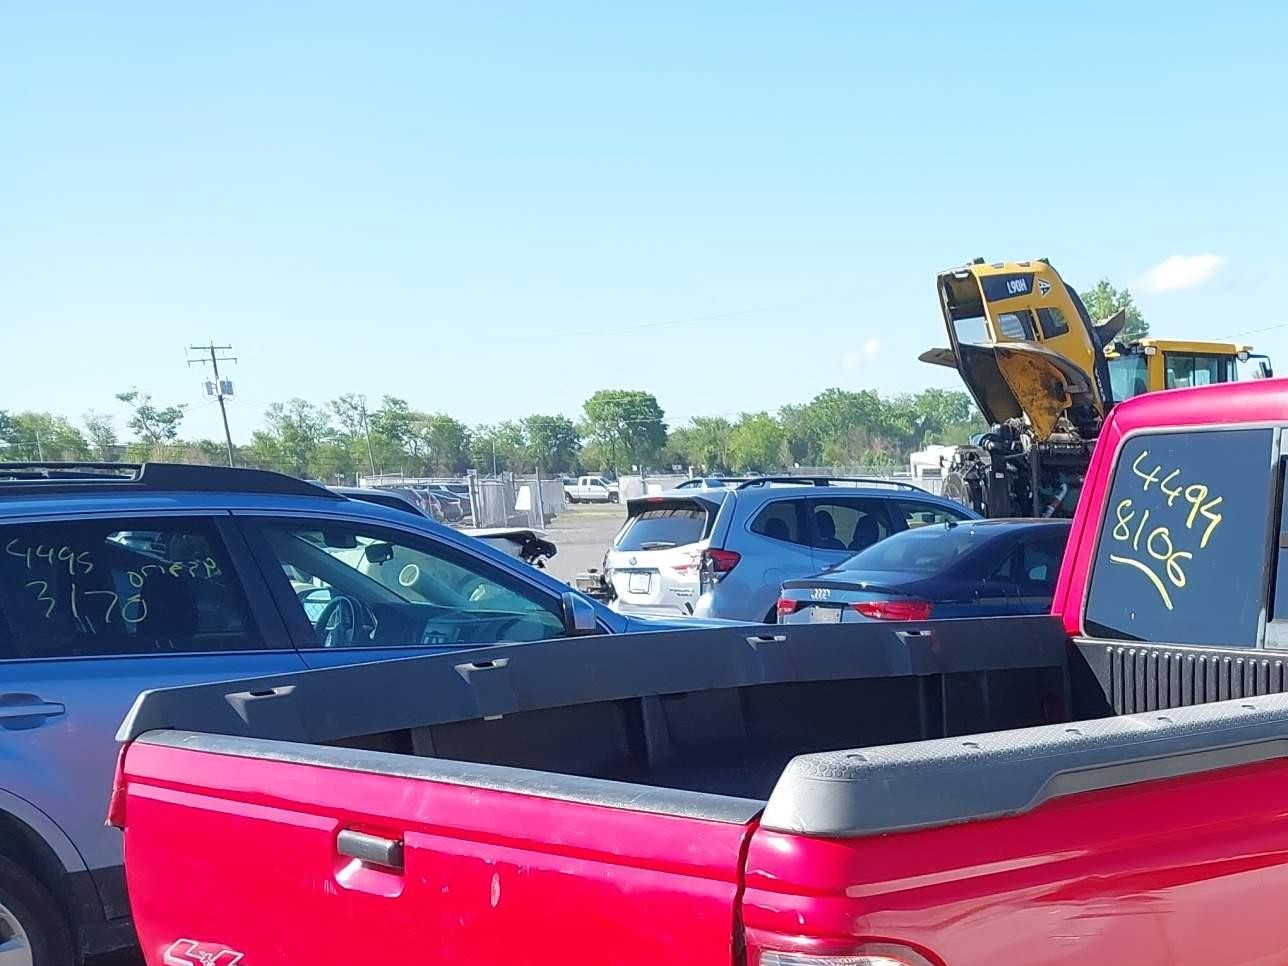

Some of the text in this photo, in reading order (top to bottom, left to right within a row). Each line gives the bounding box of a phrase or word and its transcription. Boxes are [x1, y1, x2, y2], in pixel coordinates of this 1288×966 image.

[1006, 278, 1028, 294] L90H
[1113, 499, 1193, 587] 8106
[25, 580, 148, 624] 3170
